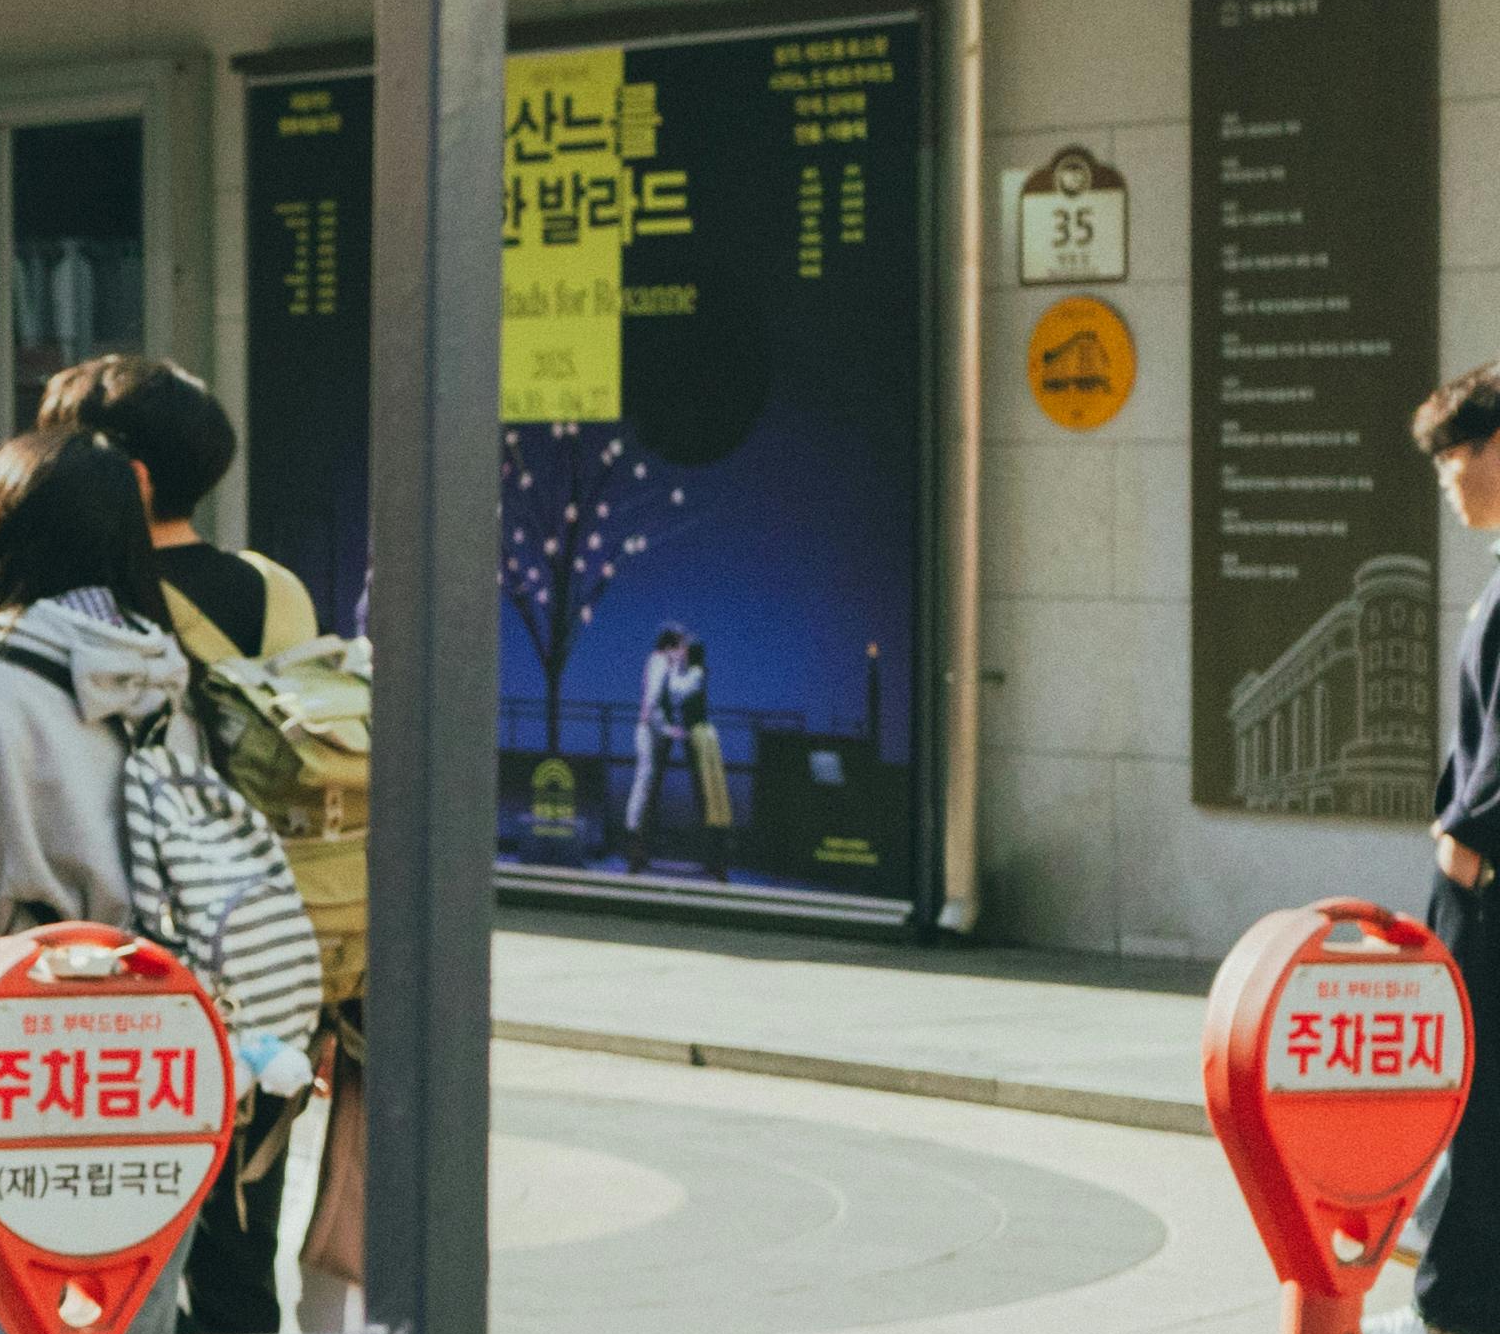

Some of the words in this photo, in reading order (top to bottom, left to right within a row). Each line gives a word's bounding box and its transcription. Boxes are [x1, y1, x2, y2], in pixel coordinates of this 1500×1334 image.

[503, 81, 664, 165] 산느를
[537, 170, 695, 247] 발라드
[1052, 206, 1095, 249] 35
[1286, 1011, 1445, 1077] 주차금지
